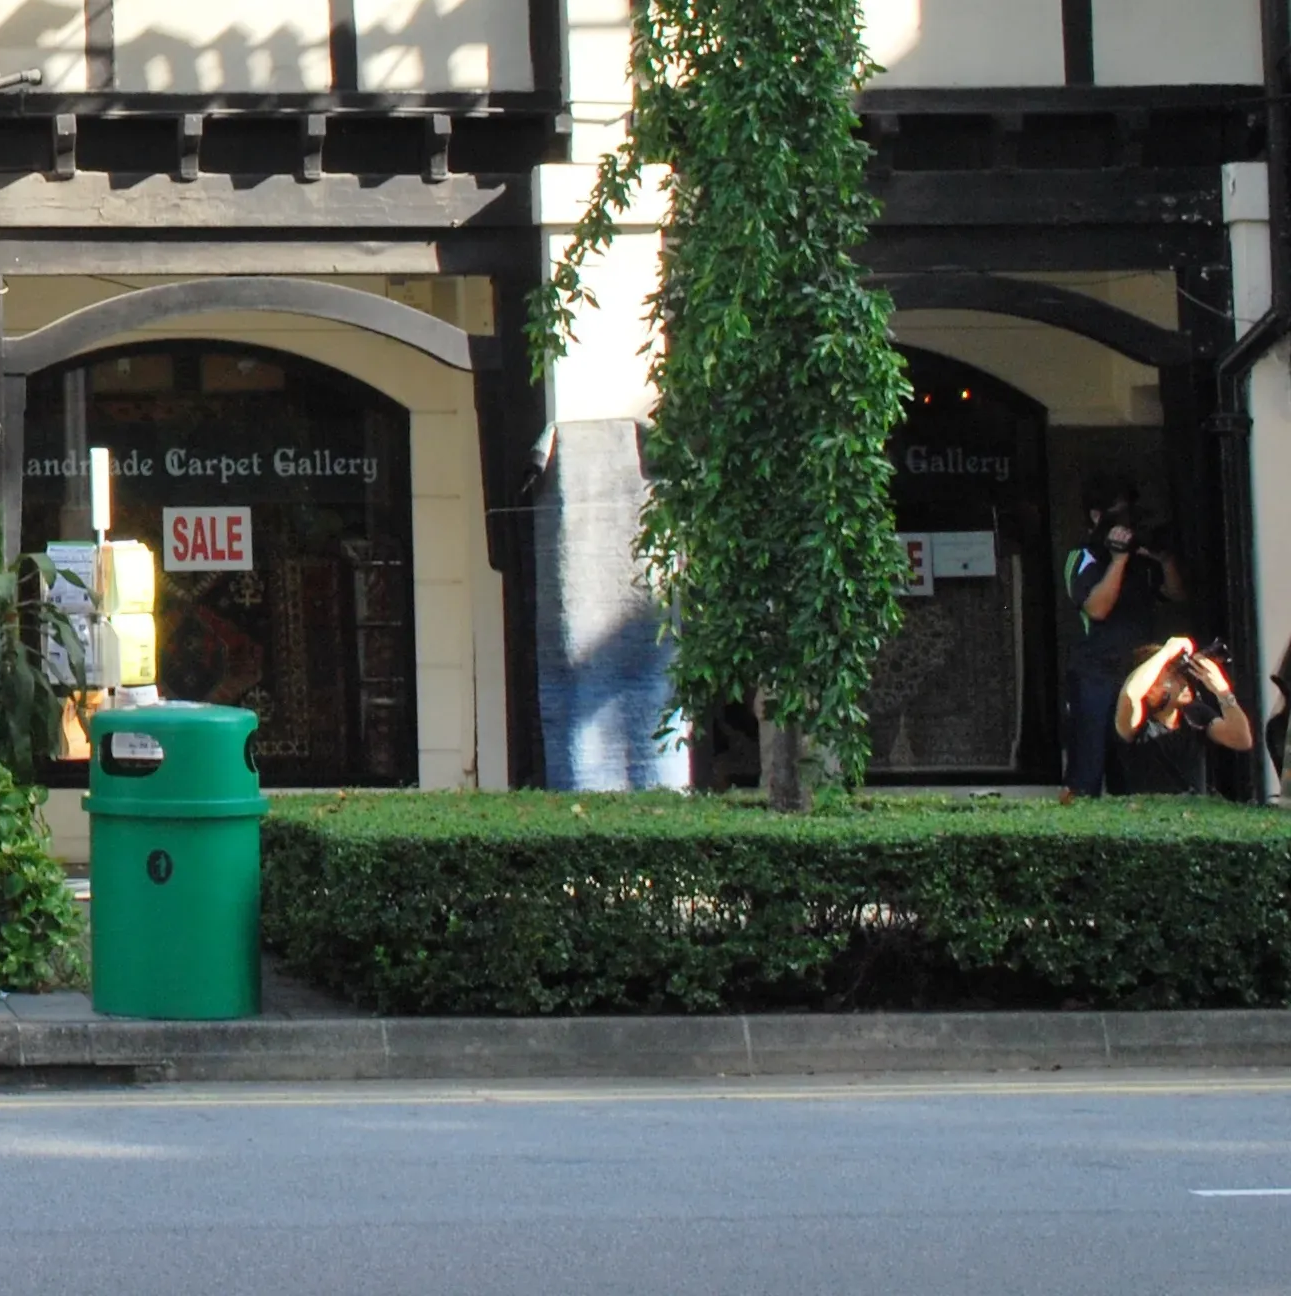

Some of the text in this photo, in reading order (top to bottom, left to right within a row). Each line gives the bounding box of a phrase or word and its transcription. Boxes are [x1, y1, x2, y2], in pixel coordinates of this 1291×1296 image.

[23, 447, 378, 483] andade Carpet Gallery
[905, 446, 1010, 482] Gallery
[171, 516, 244, 561] SALE
